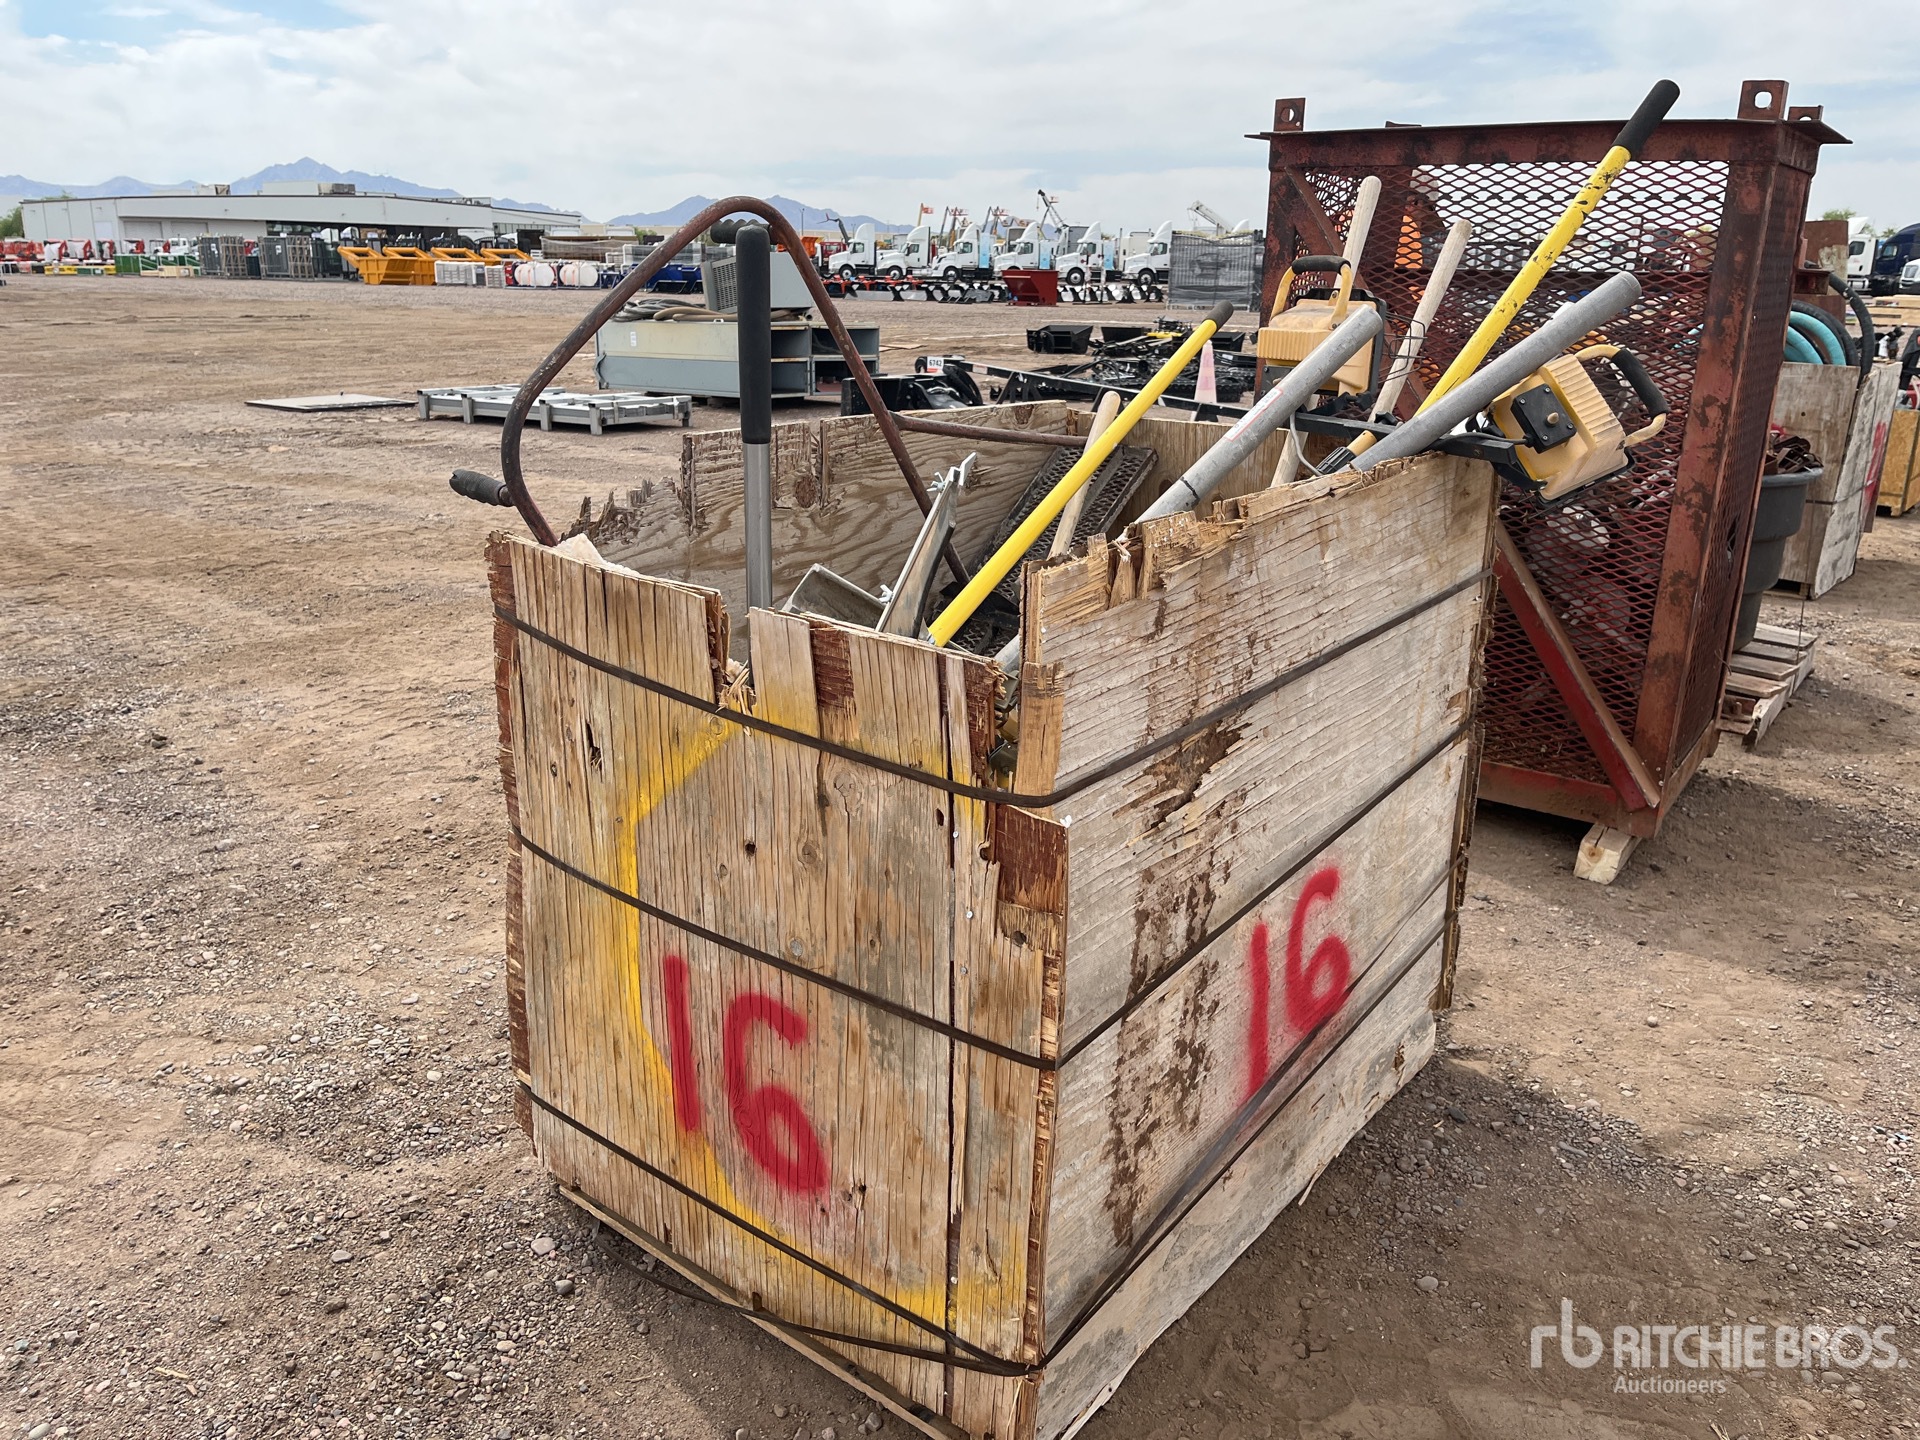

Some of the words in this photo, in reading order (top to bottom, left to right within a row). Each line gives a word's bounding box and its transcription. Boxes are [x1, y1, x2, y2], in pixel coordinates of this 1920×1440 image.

[928, 359, 942, 367] 6742
[663, 954, 828, 1196] 16
[1245, 865, 1352, 1104] 16
